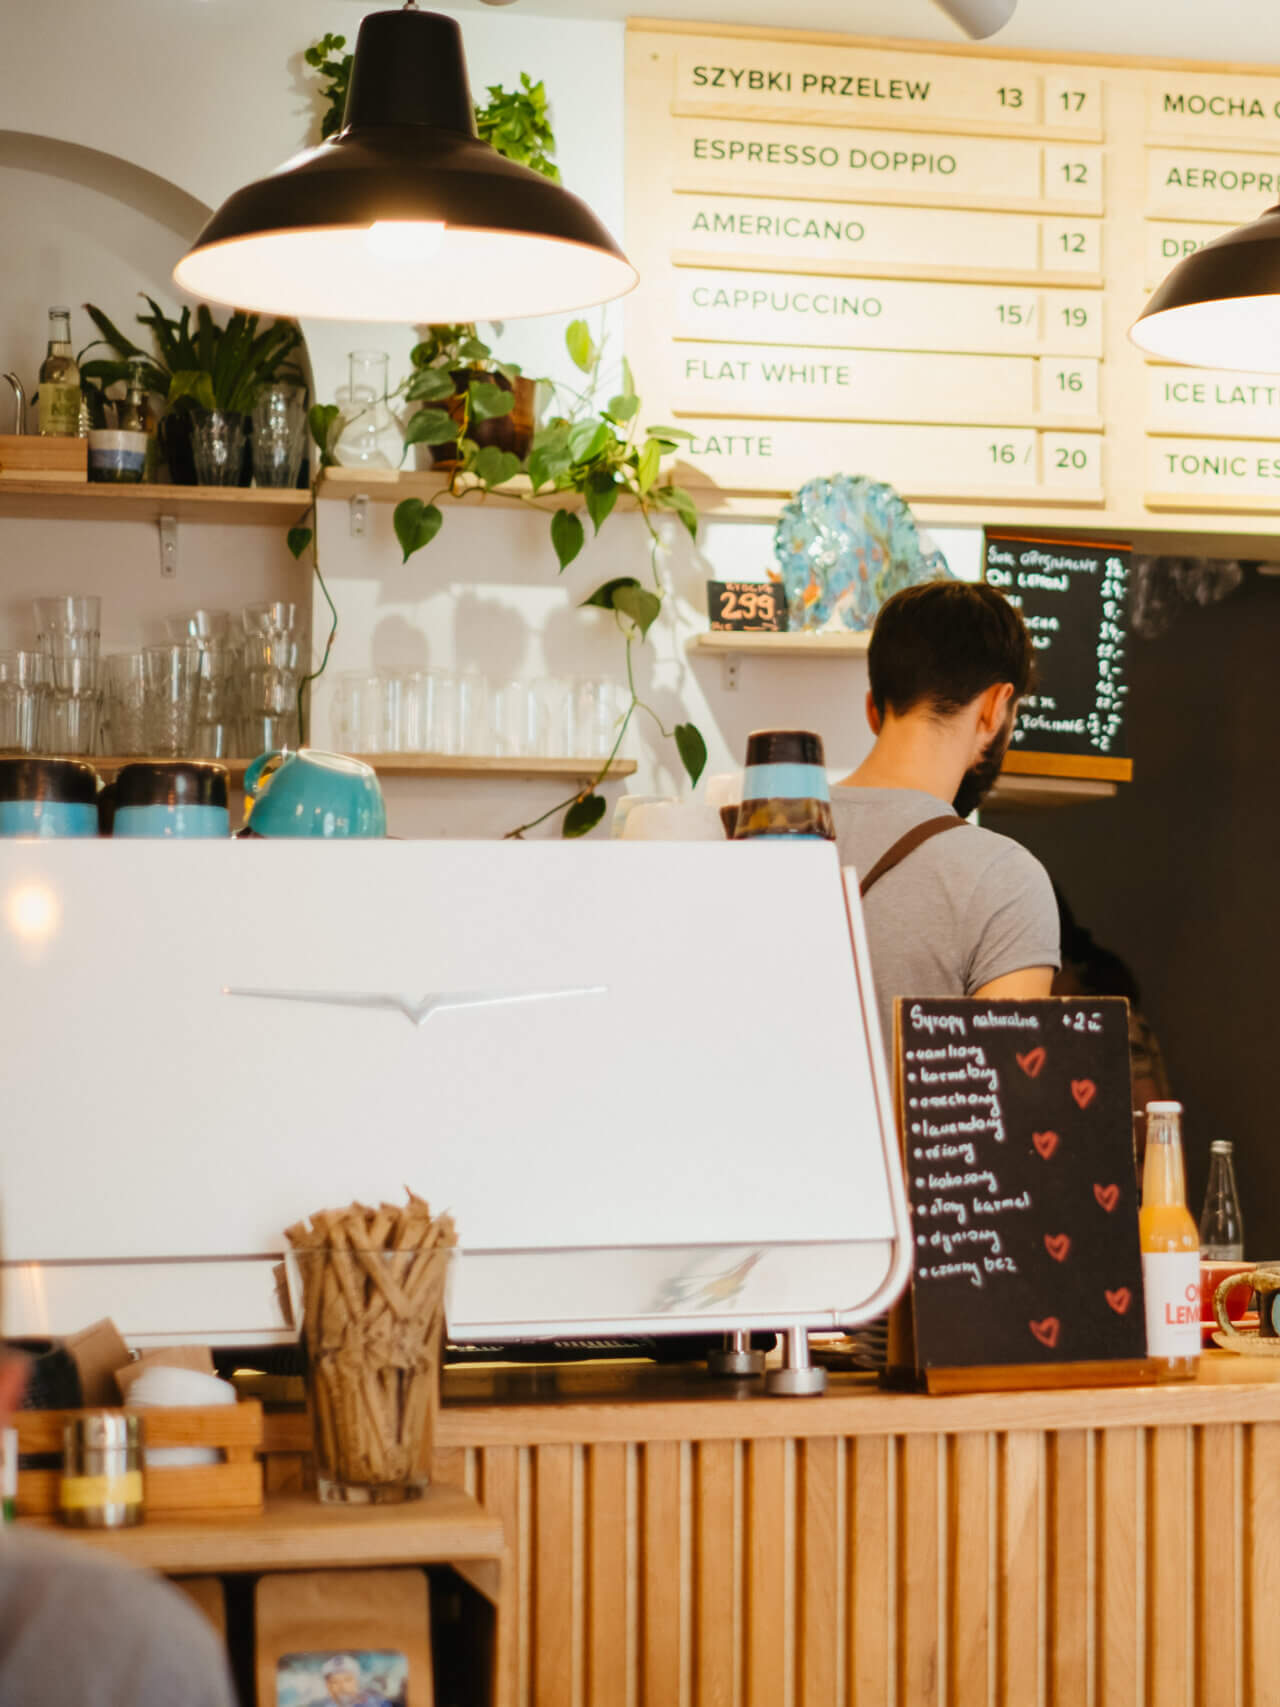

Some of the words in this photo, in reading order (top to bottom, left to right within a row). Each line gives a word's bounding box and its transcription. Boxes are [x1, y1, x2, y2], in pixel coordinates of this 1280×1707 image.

[693, 66, 792, 92] SZYBKI
[802, 74, 931, 101] PRZELEW
[997, 87, 1023, 108] 13
[1060, 91, 1087, 112] 17
[1163, 93, 1265, 118] MOCHA
[693, 138, 839, 168] ESPRESSO
[850, 148, 957, 176] DOPPIO
[1061, 163, 1088, 184] 12
[691, 211, 865, 243] AMERICANO
[1060, 233, 1086, 254] 12
[692, 286, 883, 319] CAPPUCCINO
[1061, 307, 1087, 328] 19
[685, 359, 749, 384] FLAT
[761, 363, 851, 387] WHITE
[1056, 371, 1083, 392] 16
[1165, 382, 1206, 403] ICE
[688, 434, 773, 457] LATTE
[989, 443, 1016, 464] 16
[1055, 447, 1088, 469] 20
[1165, 453, 1248, 478] TONIC
[973, 1190, 1031, 1213] karmel
